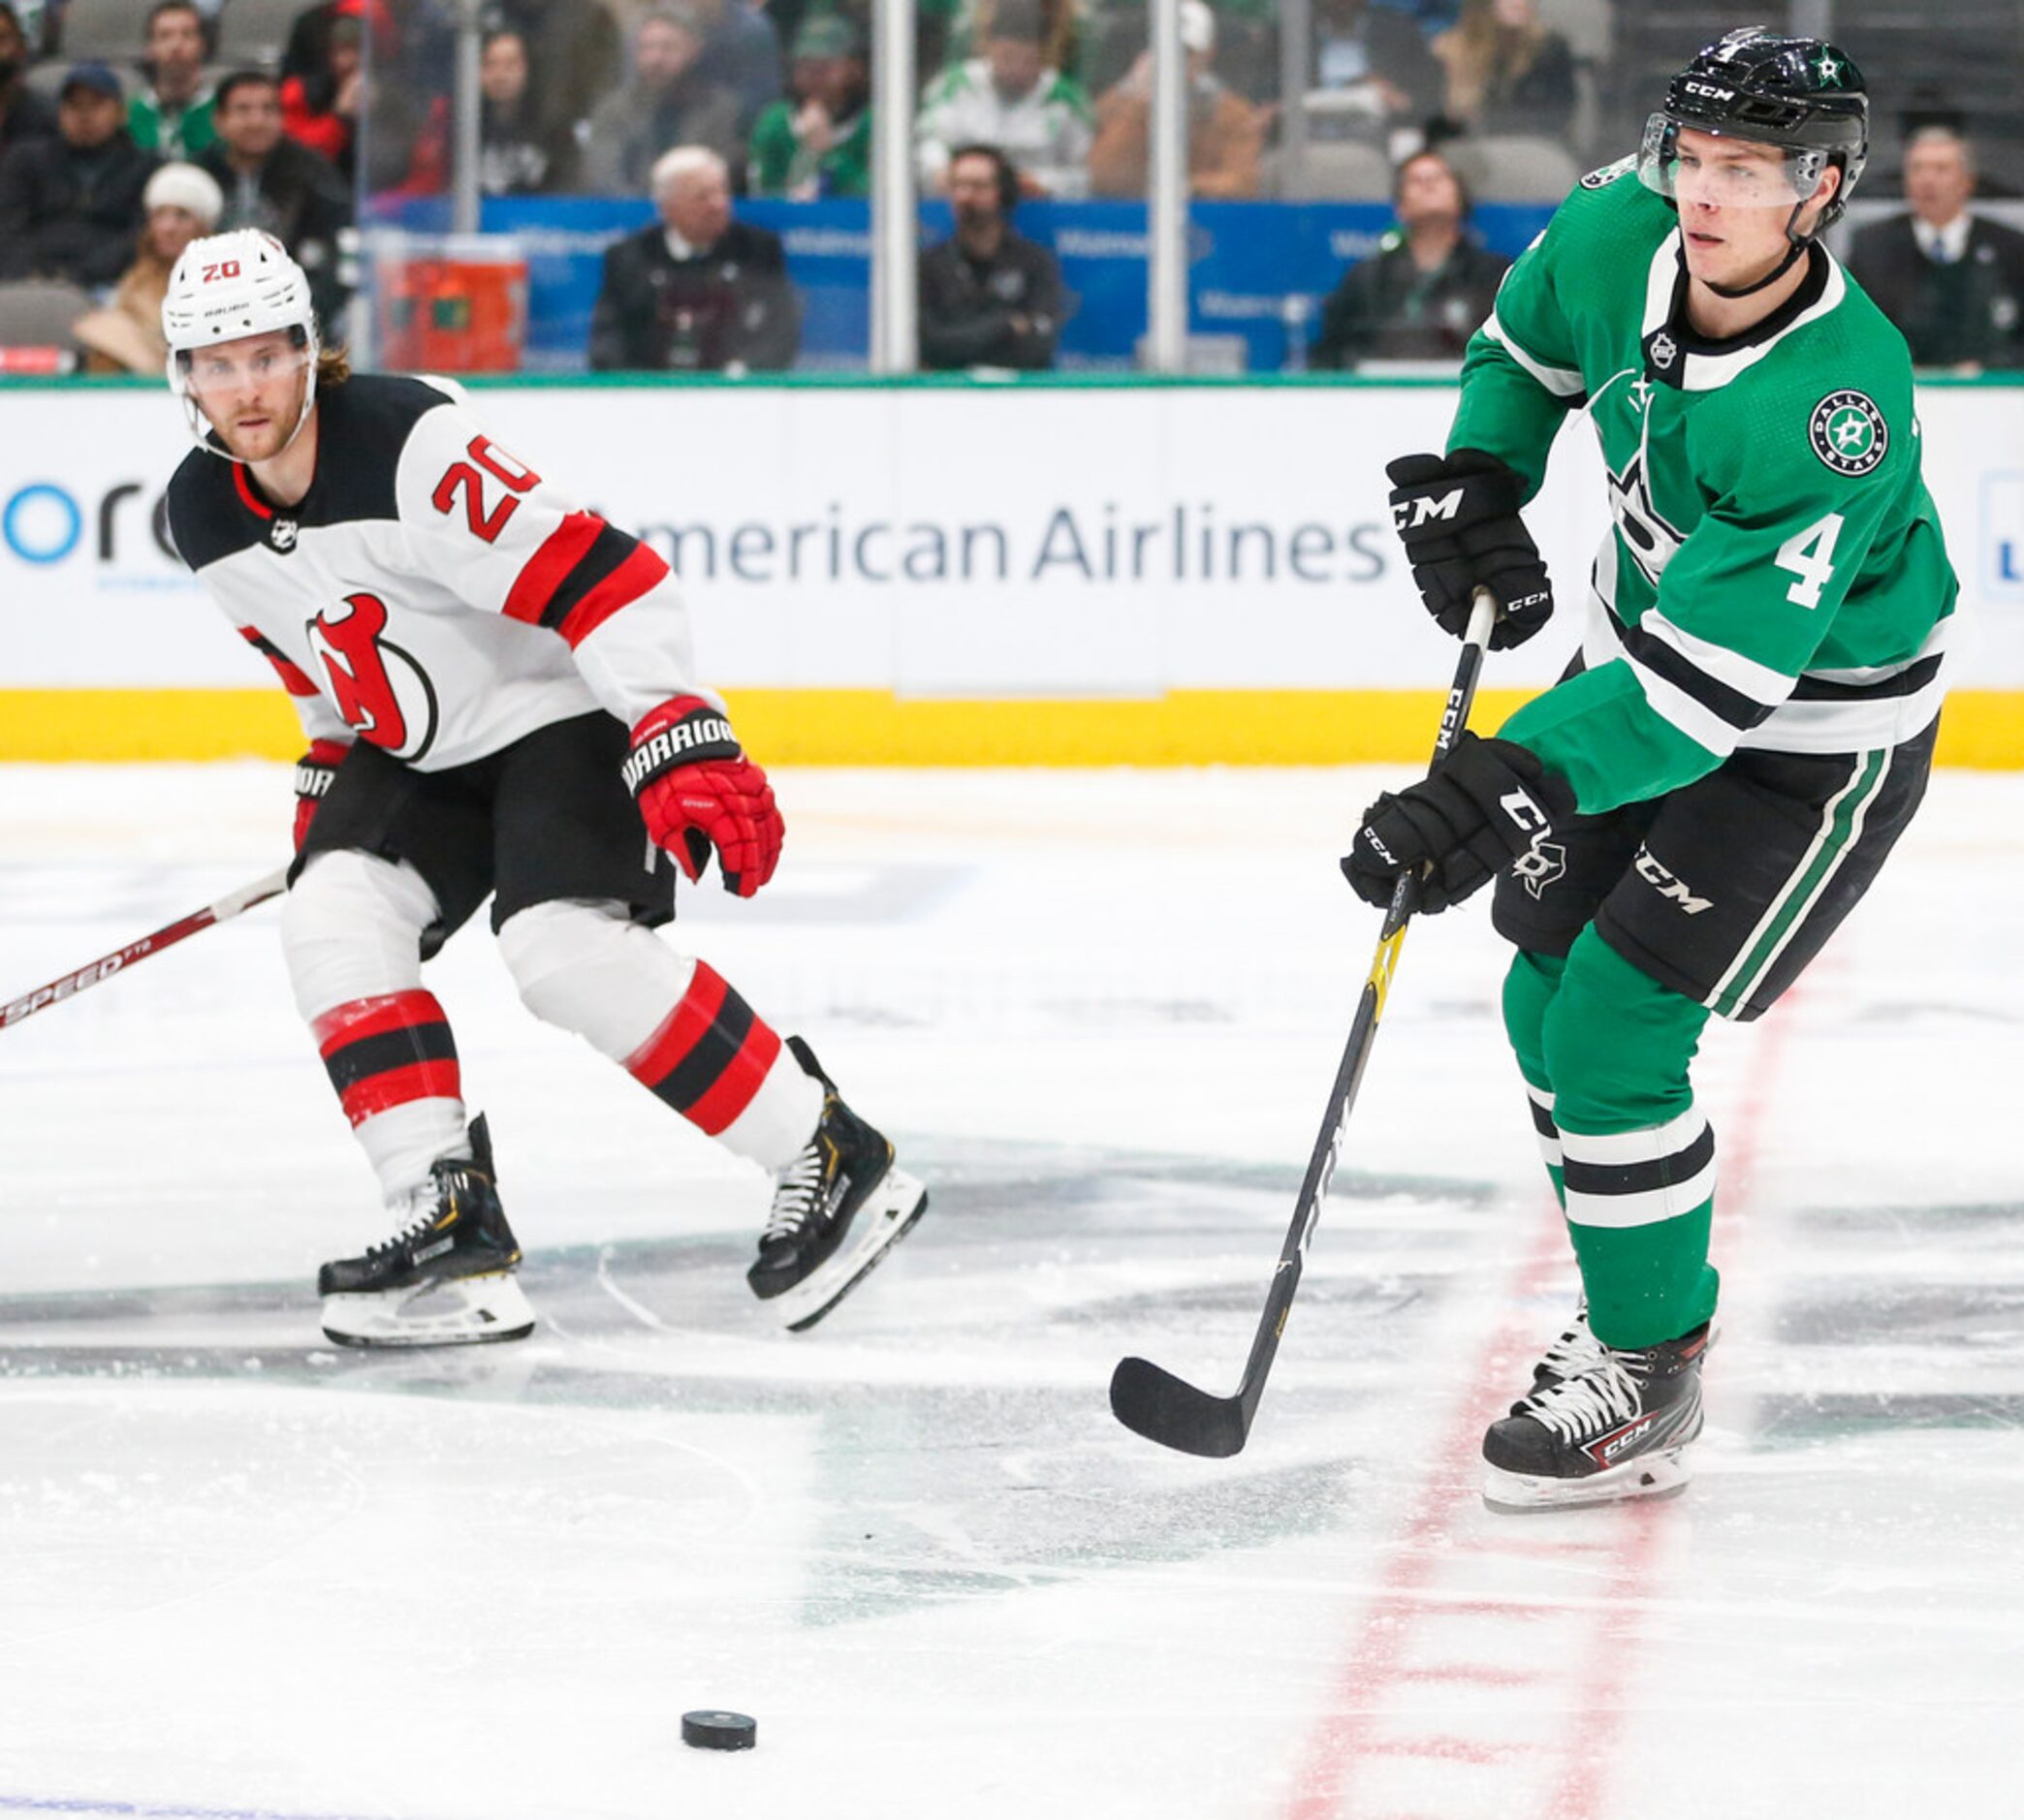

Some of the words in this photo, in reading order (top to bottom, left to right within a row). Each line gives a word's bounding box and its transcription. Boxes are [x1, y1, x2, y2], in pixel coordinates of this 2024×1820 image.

[1685, 80, 1736, 102] CCM
[203, 260, 240, 284] 20
[1814, 393, 1880, 433] DALLAS
[1824, 441, 1883, 471] STARS
[431, 433, 543, 545] 20
[593, 500, 1009, 584] merican
[1030, 502, 1387, 583] Airlines
[1773, 511, 1846, 611] 4
[1506, 590, 1550, 612] CCM
[1435, 687, 1465, 751] CCM
[1363, 826, 1399, 865] CCM
[1603, 1419, 1651, 1458] CCM
